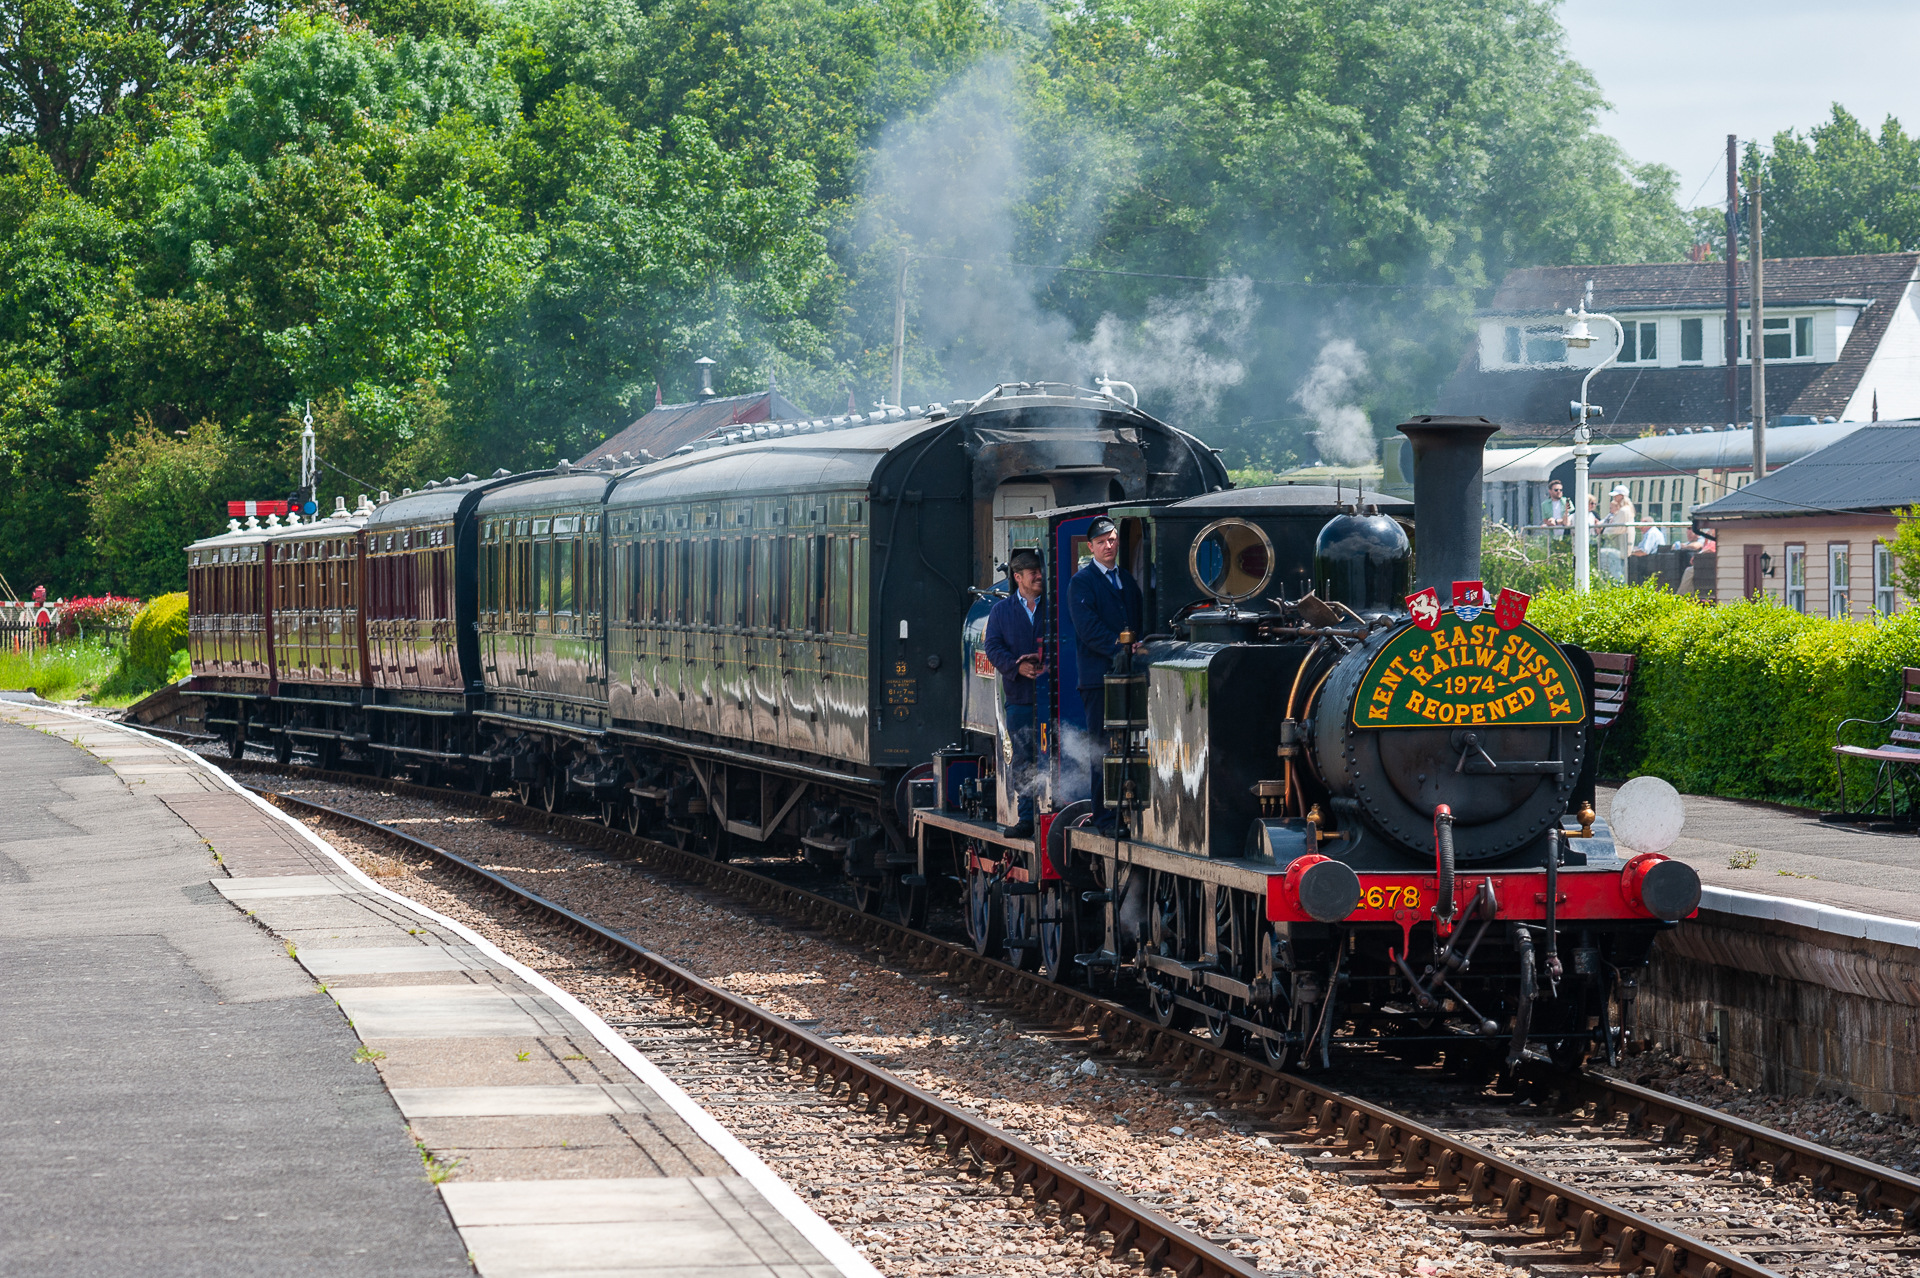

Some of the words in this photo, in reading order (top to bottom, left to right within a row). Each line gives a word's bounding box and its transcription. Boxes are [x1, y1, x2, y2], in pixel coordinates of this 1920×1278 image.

[1368, 655, 1410, 721] KENT
[1409, 644, 1429, 663] &
[1431, 624, 1500, 652] EAST
[1502, 634, 1572, 718] SUSSEX
[1410, 646, 1532, 686] RAILWAY
[1444, 675, 1496, 695] 1974
[1405, 685, 1536, 724] REOPENED
